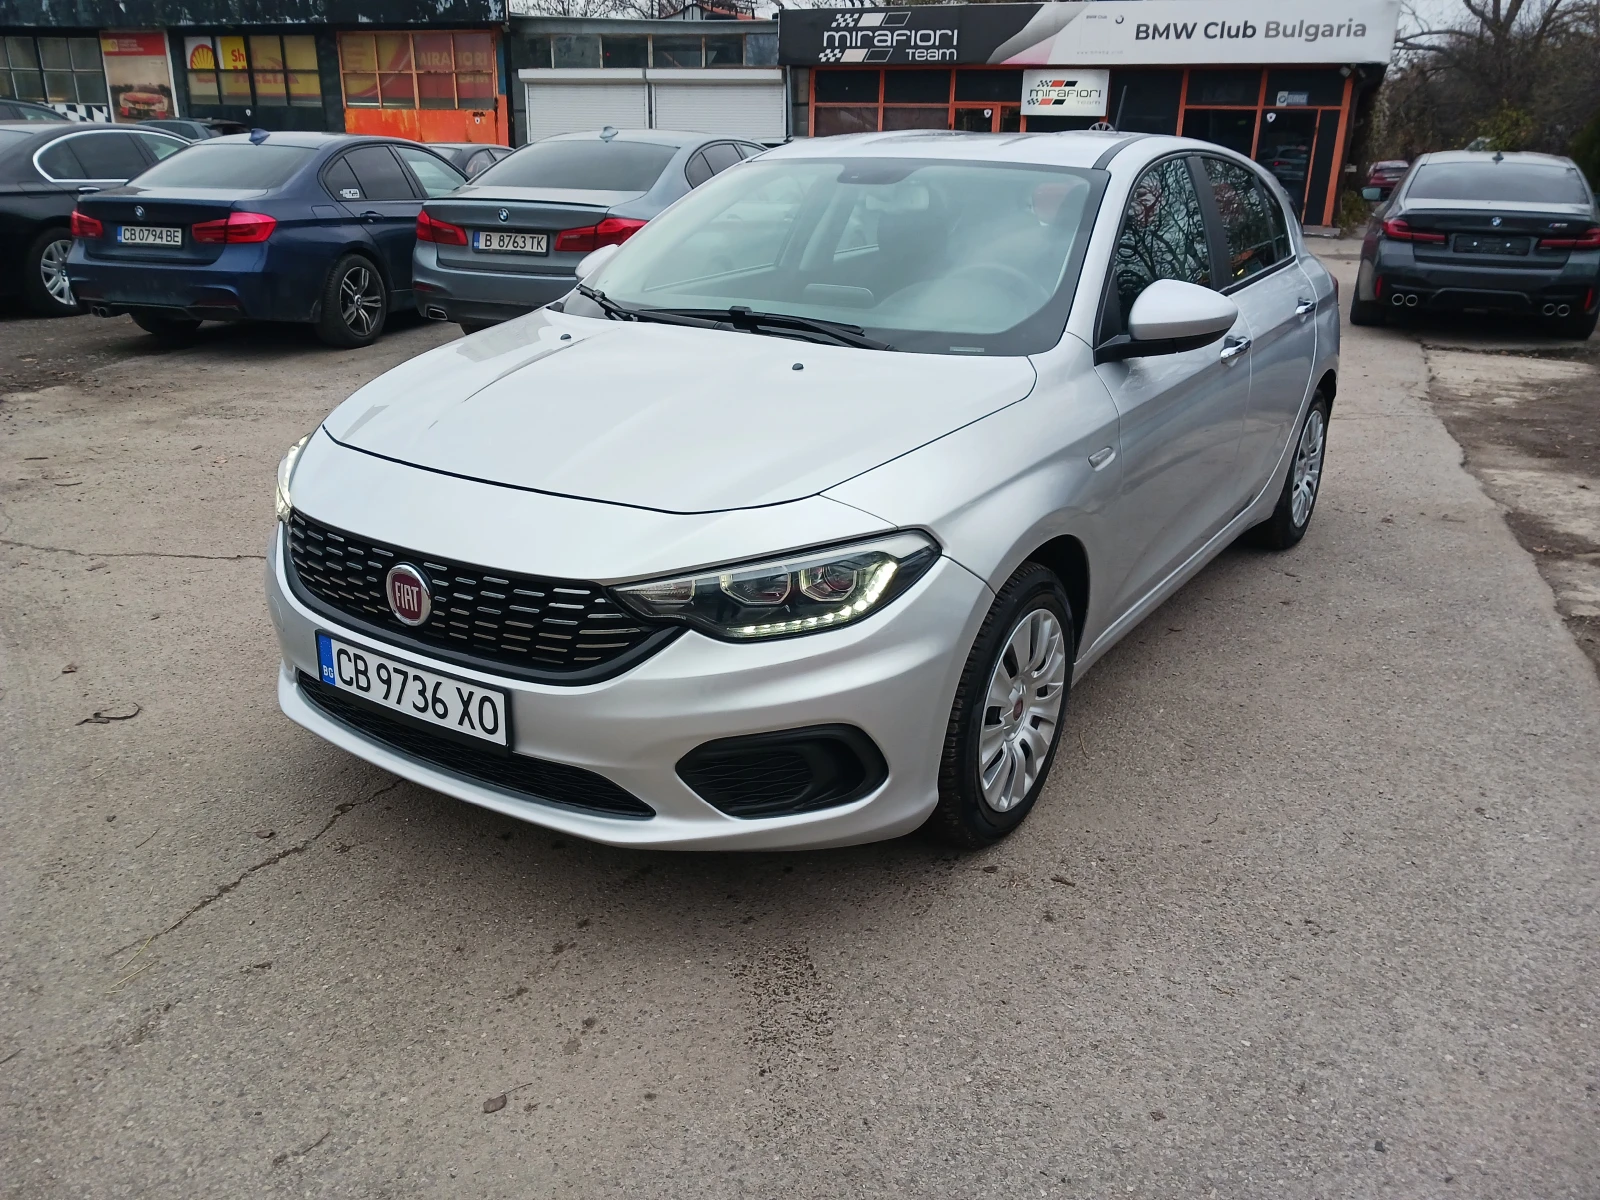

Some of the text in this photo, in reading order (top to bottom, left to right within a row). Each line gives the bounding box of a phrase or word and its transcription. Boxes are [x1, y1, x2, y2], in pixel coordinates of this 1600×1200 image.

[1134, 18, 1368, 42] BMW Club Bulgaria
[418, 51, 488, 66] MIRAIORI
[123, 228, 180, 243] CB 0794 BE
[484, 233, 544, 251] B 8763 TK
[394, 581, 420, 612] FIAT
[322, 665, 334, 679] BG
[336, 648, 499, 735] CB 9736 XO
